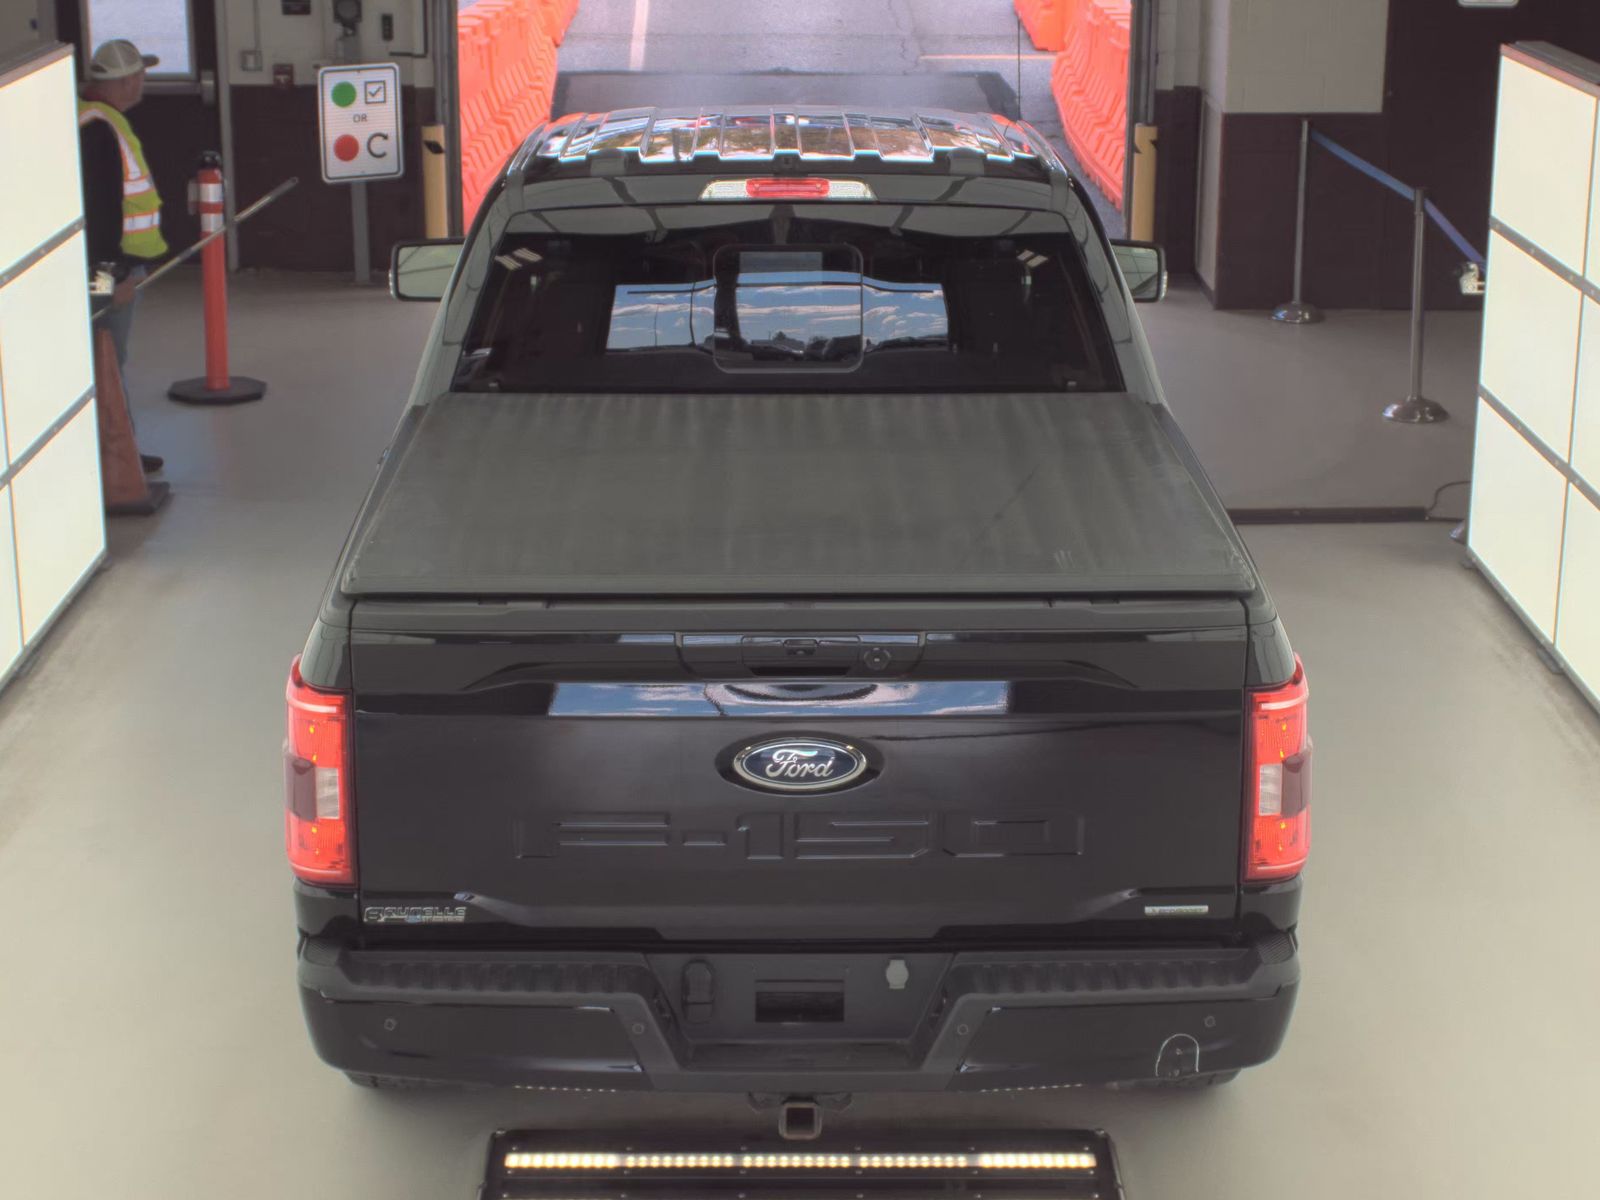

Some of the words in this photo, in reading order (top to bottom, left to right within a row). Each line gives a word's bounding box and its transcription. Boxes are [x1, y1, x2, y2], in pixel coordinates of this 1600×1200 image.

[353, 113, 368, 123] OR
[765, 749, 835, 778] Ford
[512, 811, 1086, 861] F-150
